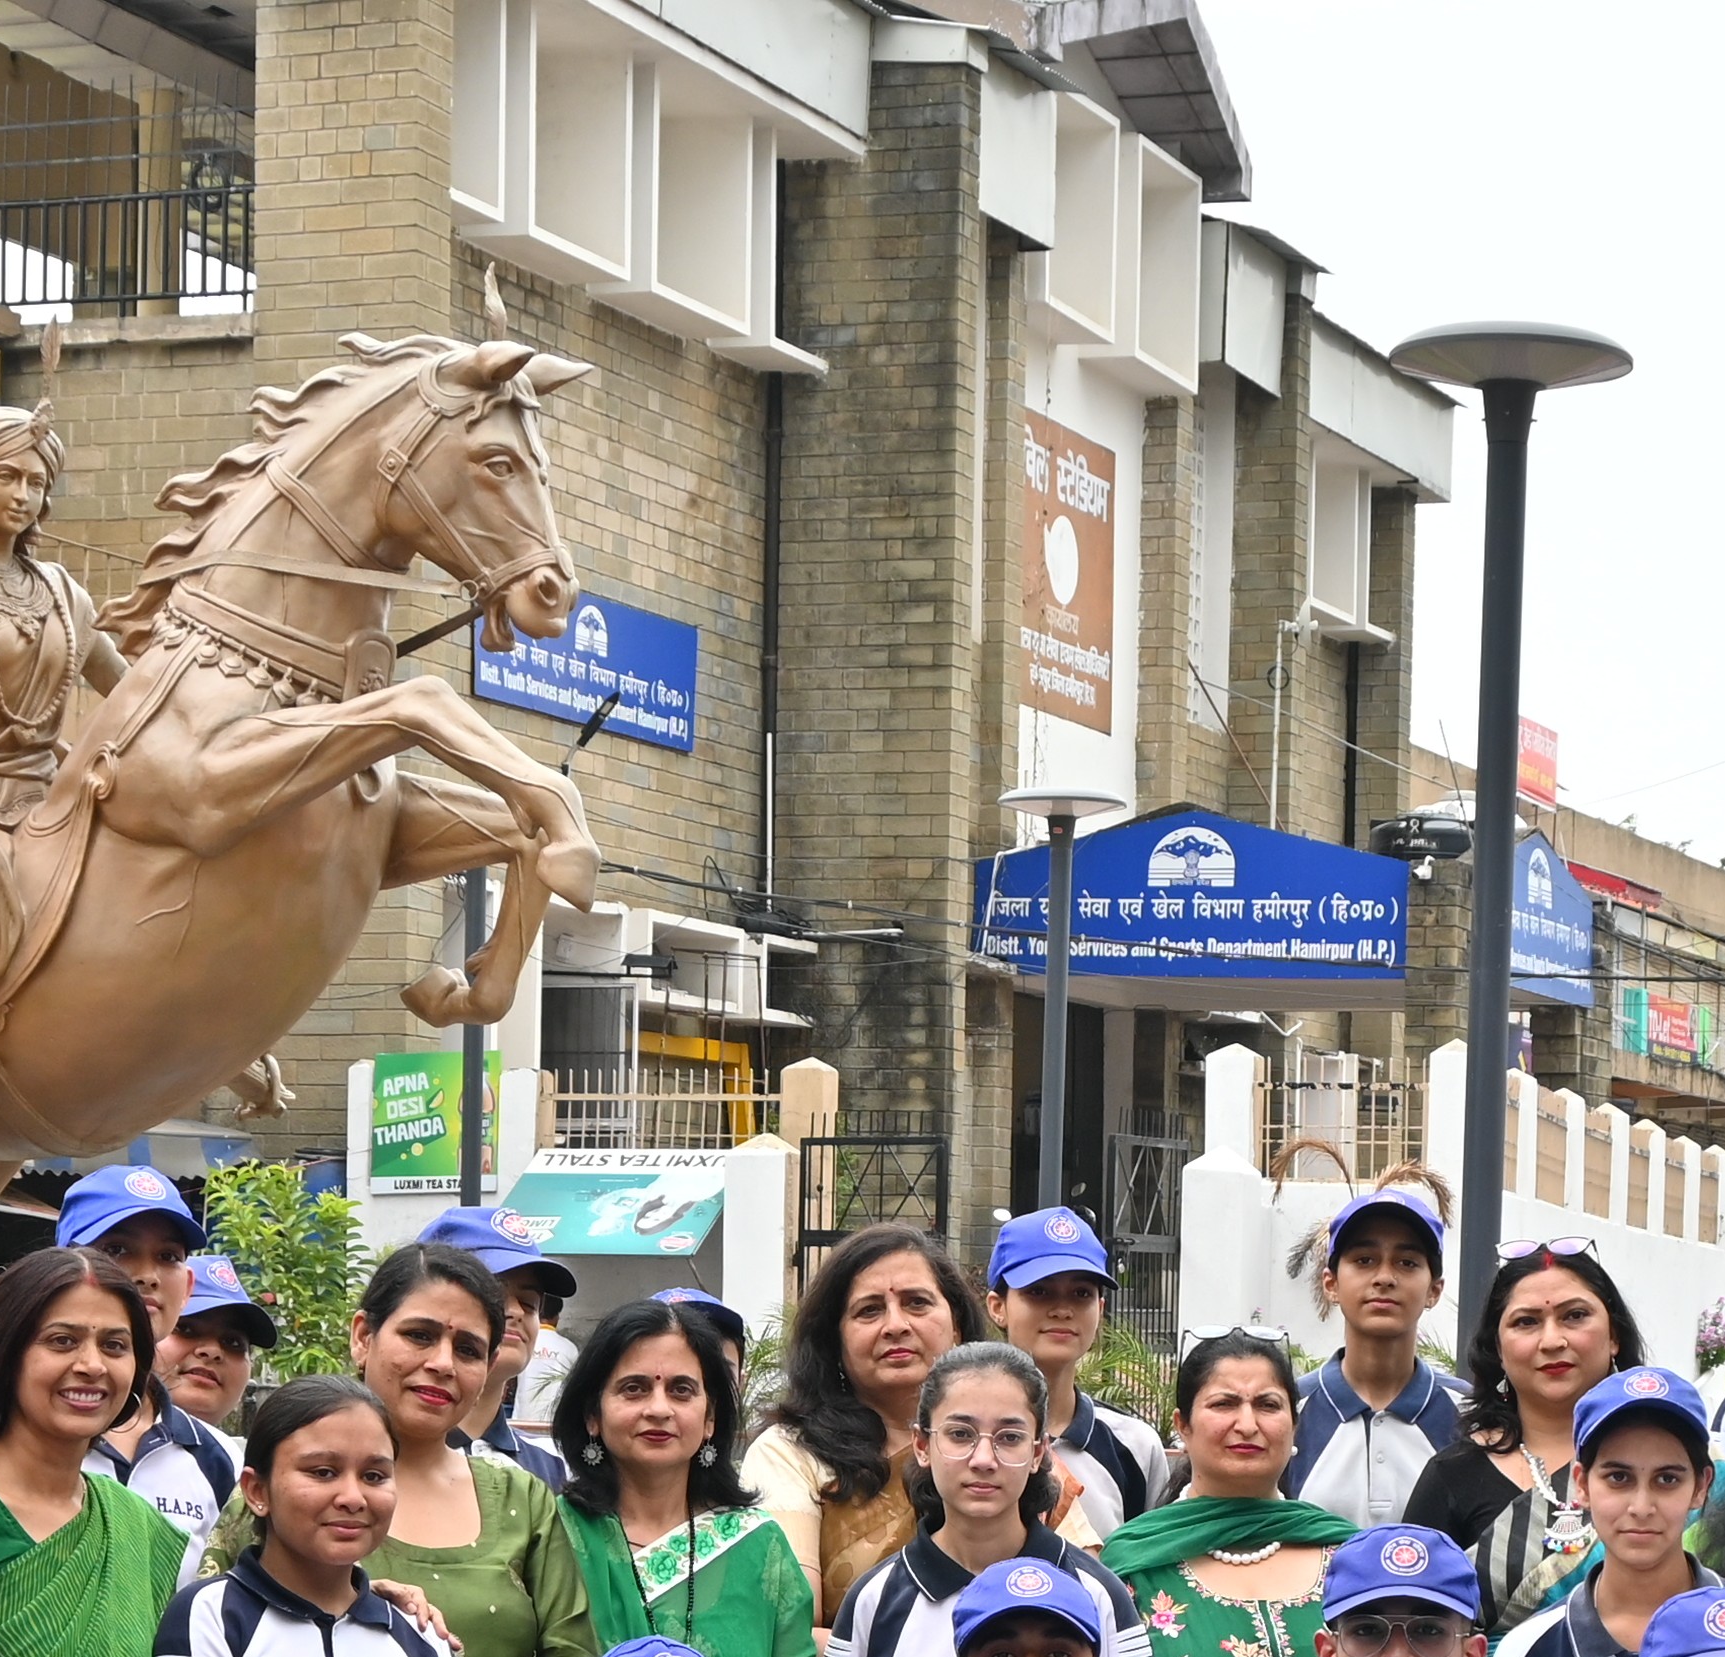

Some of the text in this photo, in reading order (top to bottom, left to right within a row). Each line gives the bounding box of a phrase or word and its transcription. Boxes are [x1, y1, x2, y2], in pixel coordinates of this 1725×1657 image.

[568, 651, 587, 680] खेल
[589, 659, 617, 689] विभाग
[1078, 889, 1109, 919] सेवा
[1118, 892, 1144, 925] एवं
[1151, 889, 1183, 919] खेल
[1193, 890, 1243, 919] विभाग
[1252, 890, 1312, 928] हमीरपुर
[1357, 938, 1396, 967] (H.P.)
[382, 1072, 429, 1098] APNA
[386, 1096, 425, 1120] DESI
[374, 1116, 444, 1146] THANDA
[543, 1153, 612, 1168] STALL
[666, 1153, 725, 1168] UXMI
[394, 1178, 443, 1190] LUXMI TEA
[156, 1497, 204, 1521] H.A.P.S
